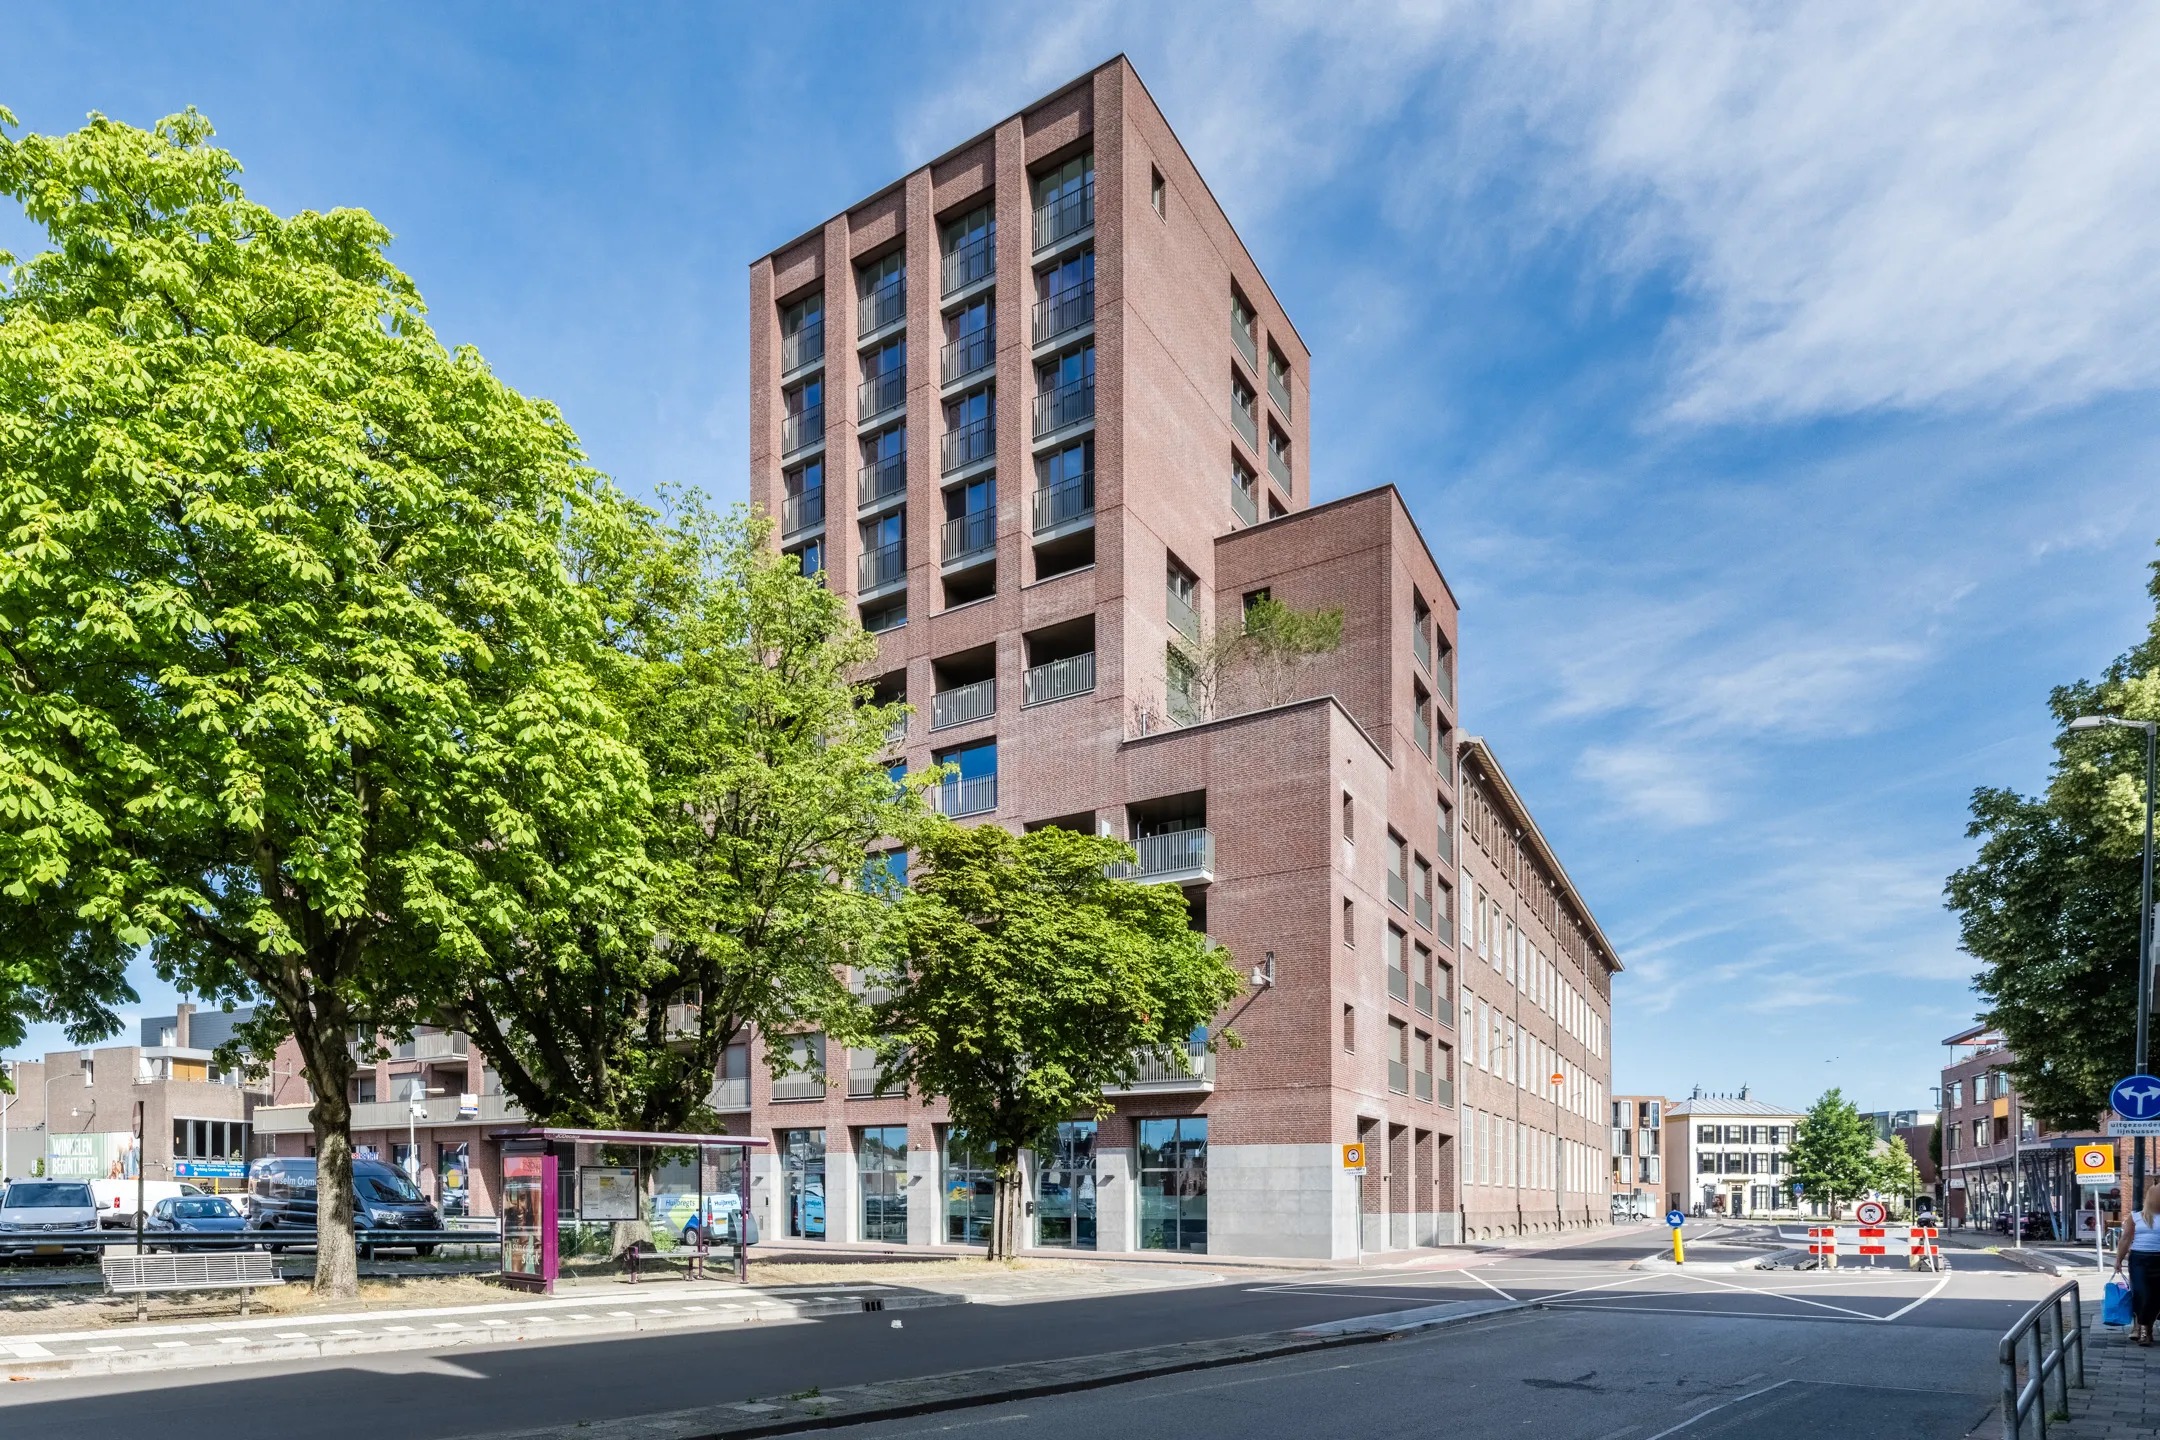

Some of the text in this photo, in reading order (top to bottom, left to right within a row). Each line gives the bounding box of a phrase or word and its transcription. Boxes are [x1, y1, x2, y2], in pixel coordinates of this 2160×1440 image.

[52, 1138, 92, 1156] WINKELEN
[52, 1157, 98, 1174] BEGINT HIER!
[665, 1199, 696, 1208] Huijbregts
